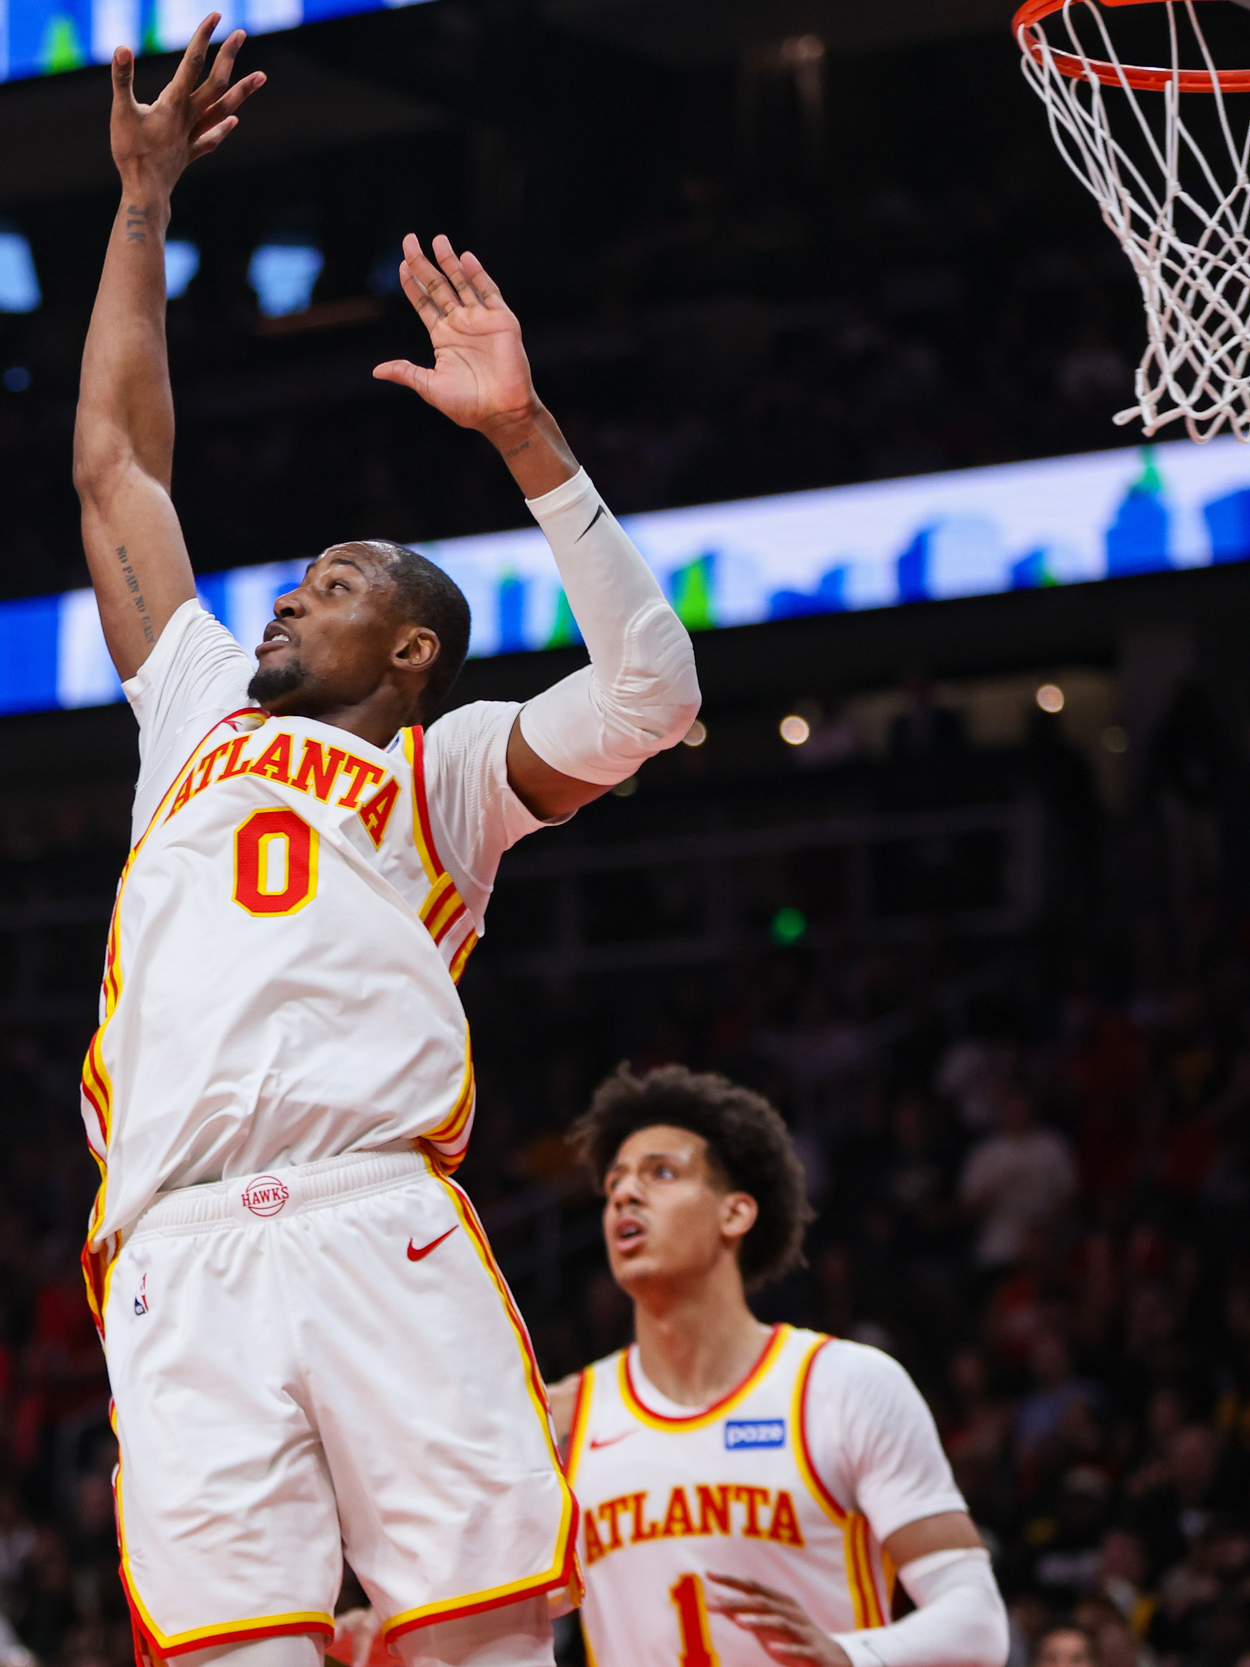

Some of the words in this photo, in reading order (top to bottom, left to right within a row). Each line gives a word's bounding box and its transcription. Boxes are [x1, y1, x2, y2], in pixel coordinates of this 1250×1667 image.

[115, 545, 128, 563] NO
[122, 565, 140, 593] PAIN
[133, 596, 146, 612] NO
[160, 731, 401, 852] ATLANTA
[231, 806, 320, 917] 0
[241, 1186, 290, 1207] HAWKS
[727, 1423, 784, 1447] paze
[583, 1482, 806, 1568] ATLANTA
[669, 1572, 722, 1667] 1
